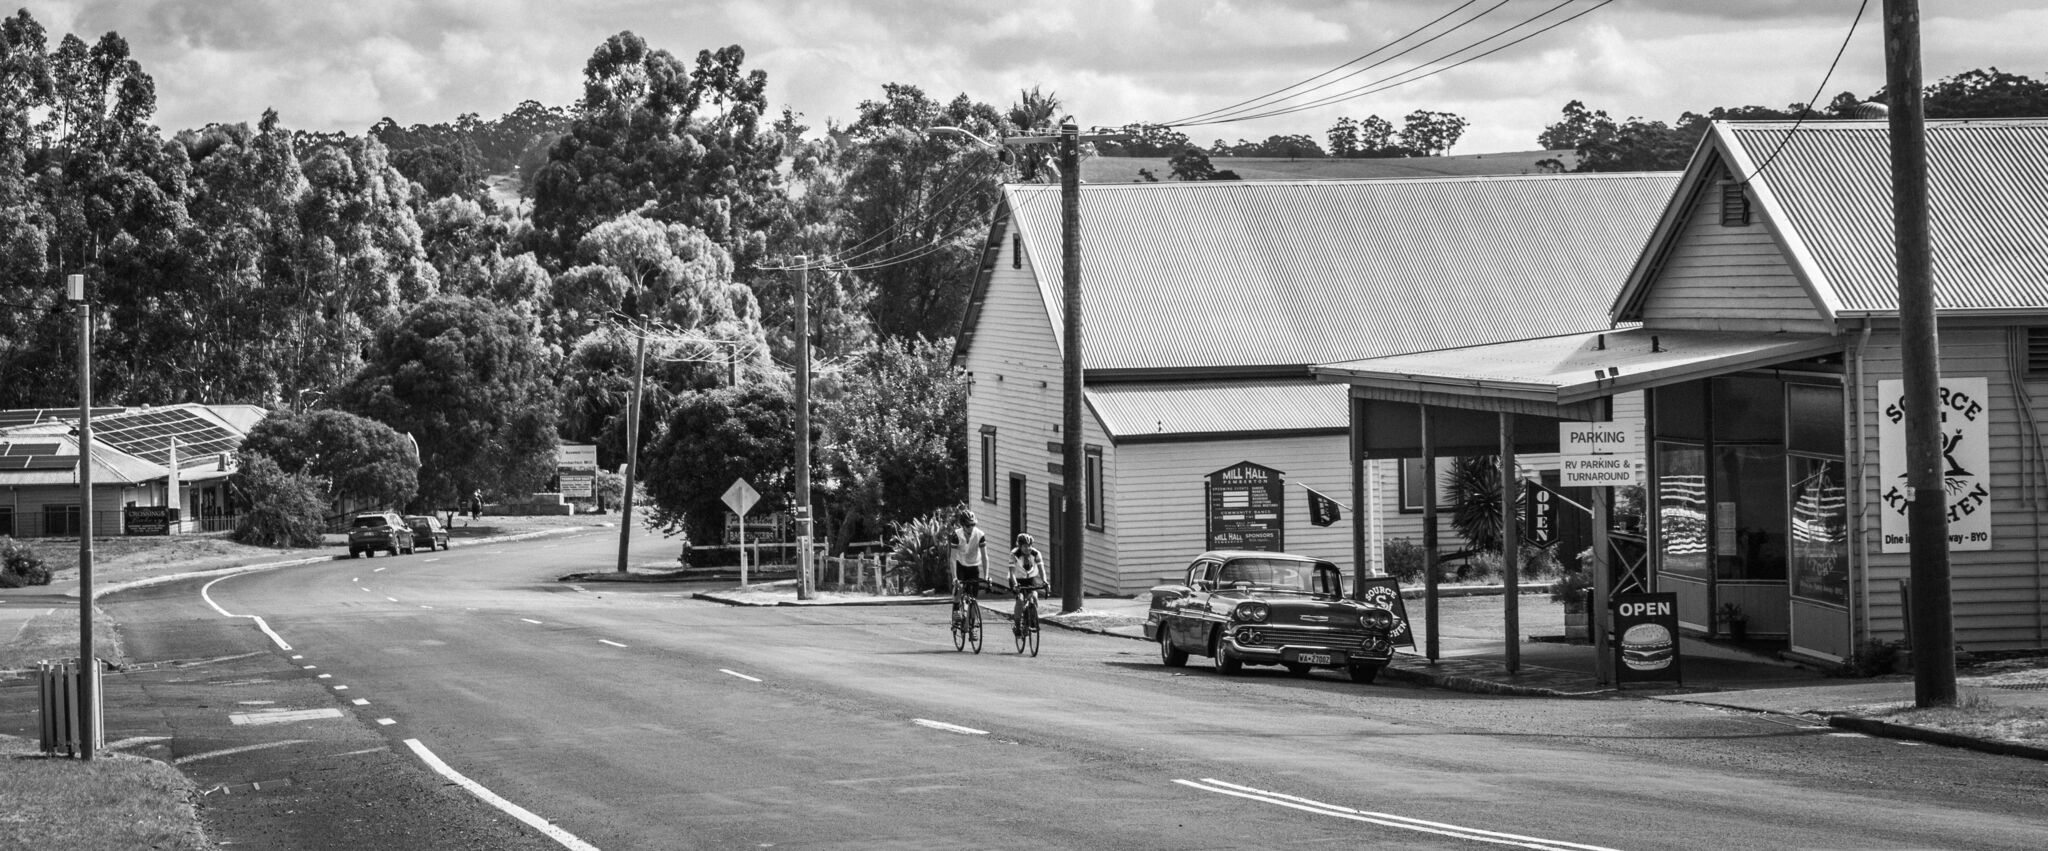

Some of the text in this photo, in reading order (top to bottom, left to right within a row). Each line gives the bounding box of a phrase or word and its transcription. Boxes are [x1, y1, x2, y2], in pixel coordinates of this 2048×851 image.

[1885, 386, 1982, 425] SRCE
[1570, 431, 1625, 444] PARKING
[1564, 459, 1631, 469] RV PARKING &
[1223, 467, 1268, 480] MILL HALL
[1566, 471, 1630, 482] TURNAROUND
[1882, 482, 1989, 523] KIHEN
[1536, 490, 1550, 542] OPEN
[1214, 533, 1227, 541] MILL
[1228, 532, 1243, 541] HALL
[1885, 535, 1904, 544] Dine
[1971, 532, 1988, 542] BYO
[1365, 586, 1397, 601] SOURCE
[1619, 602, 1671, 617] OPEN
